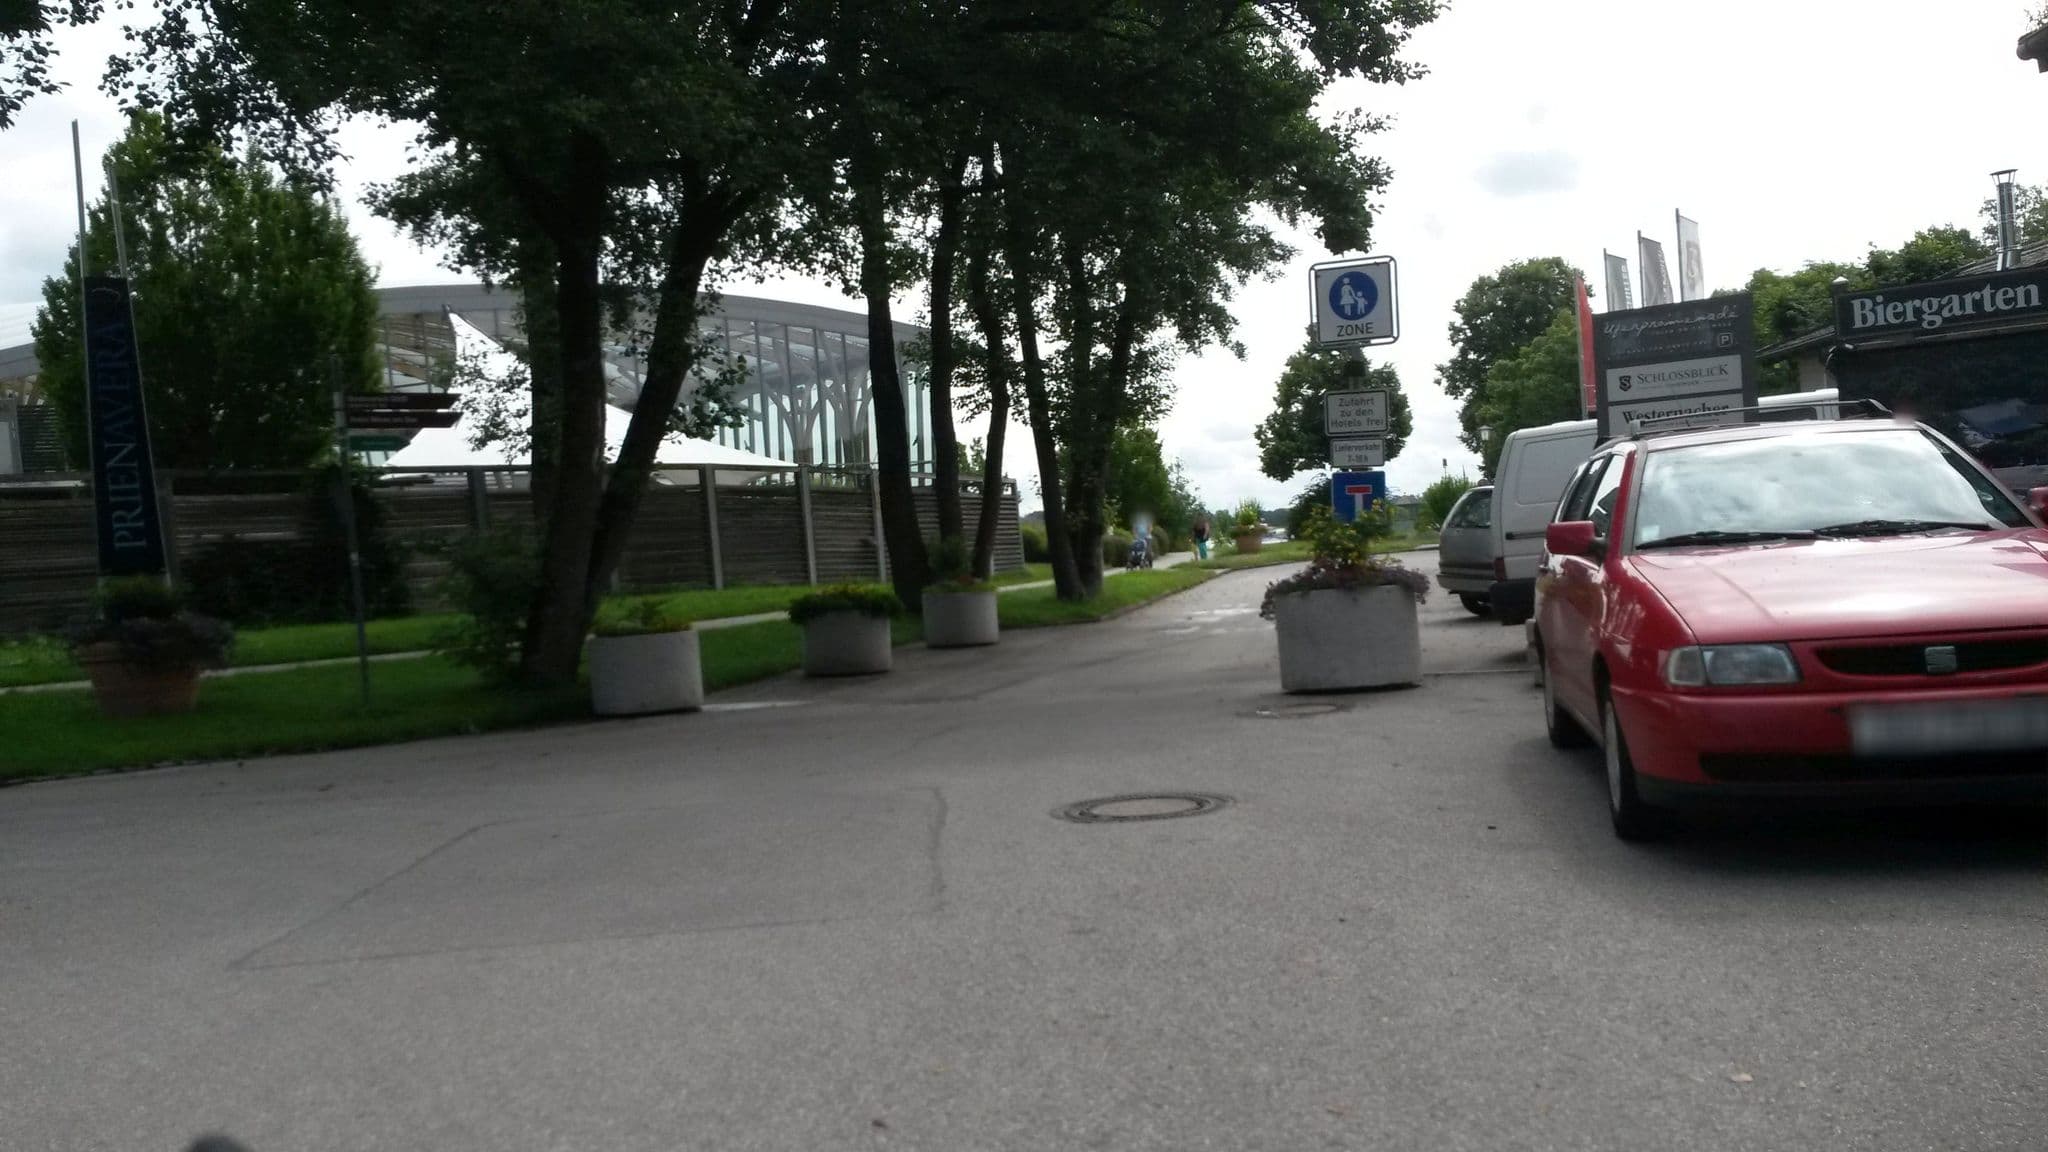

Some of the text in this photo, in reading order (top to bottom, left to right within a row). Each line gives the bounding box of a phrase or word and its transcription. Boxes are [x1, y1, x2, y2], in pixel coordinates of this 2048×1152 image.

[1851, 282, 2042, 329] Biergarten
[1336, 322, 1374, 337] ZONE
[1637, 363, 1729, 385] SCHLOSSBLICK
[1338, 397, 1375, 407] Zufahrt
[1340, 407, 1374, 418] zu den
[1330, 416, 1385, 428] Hotels frei
[96, 321, 147, 550] PRIENAVERA
